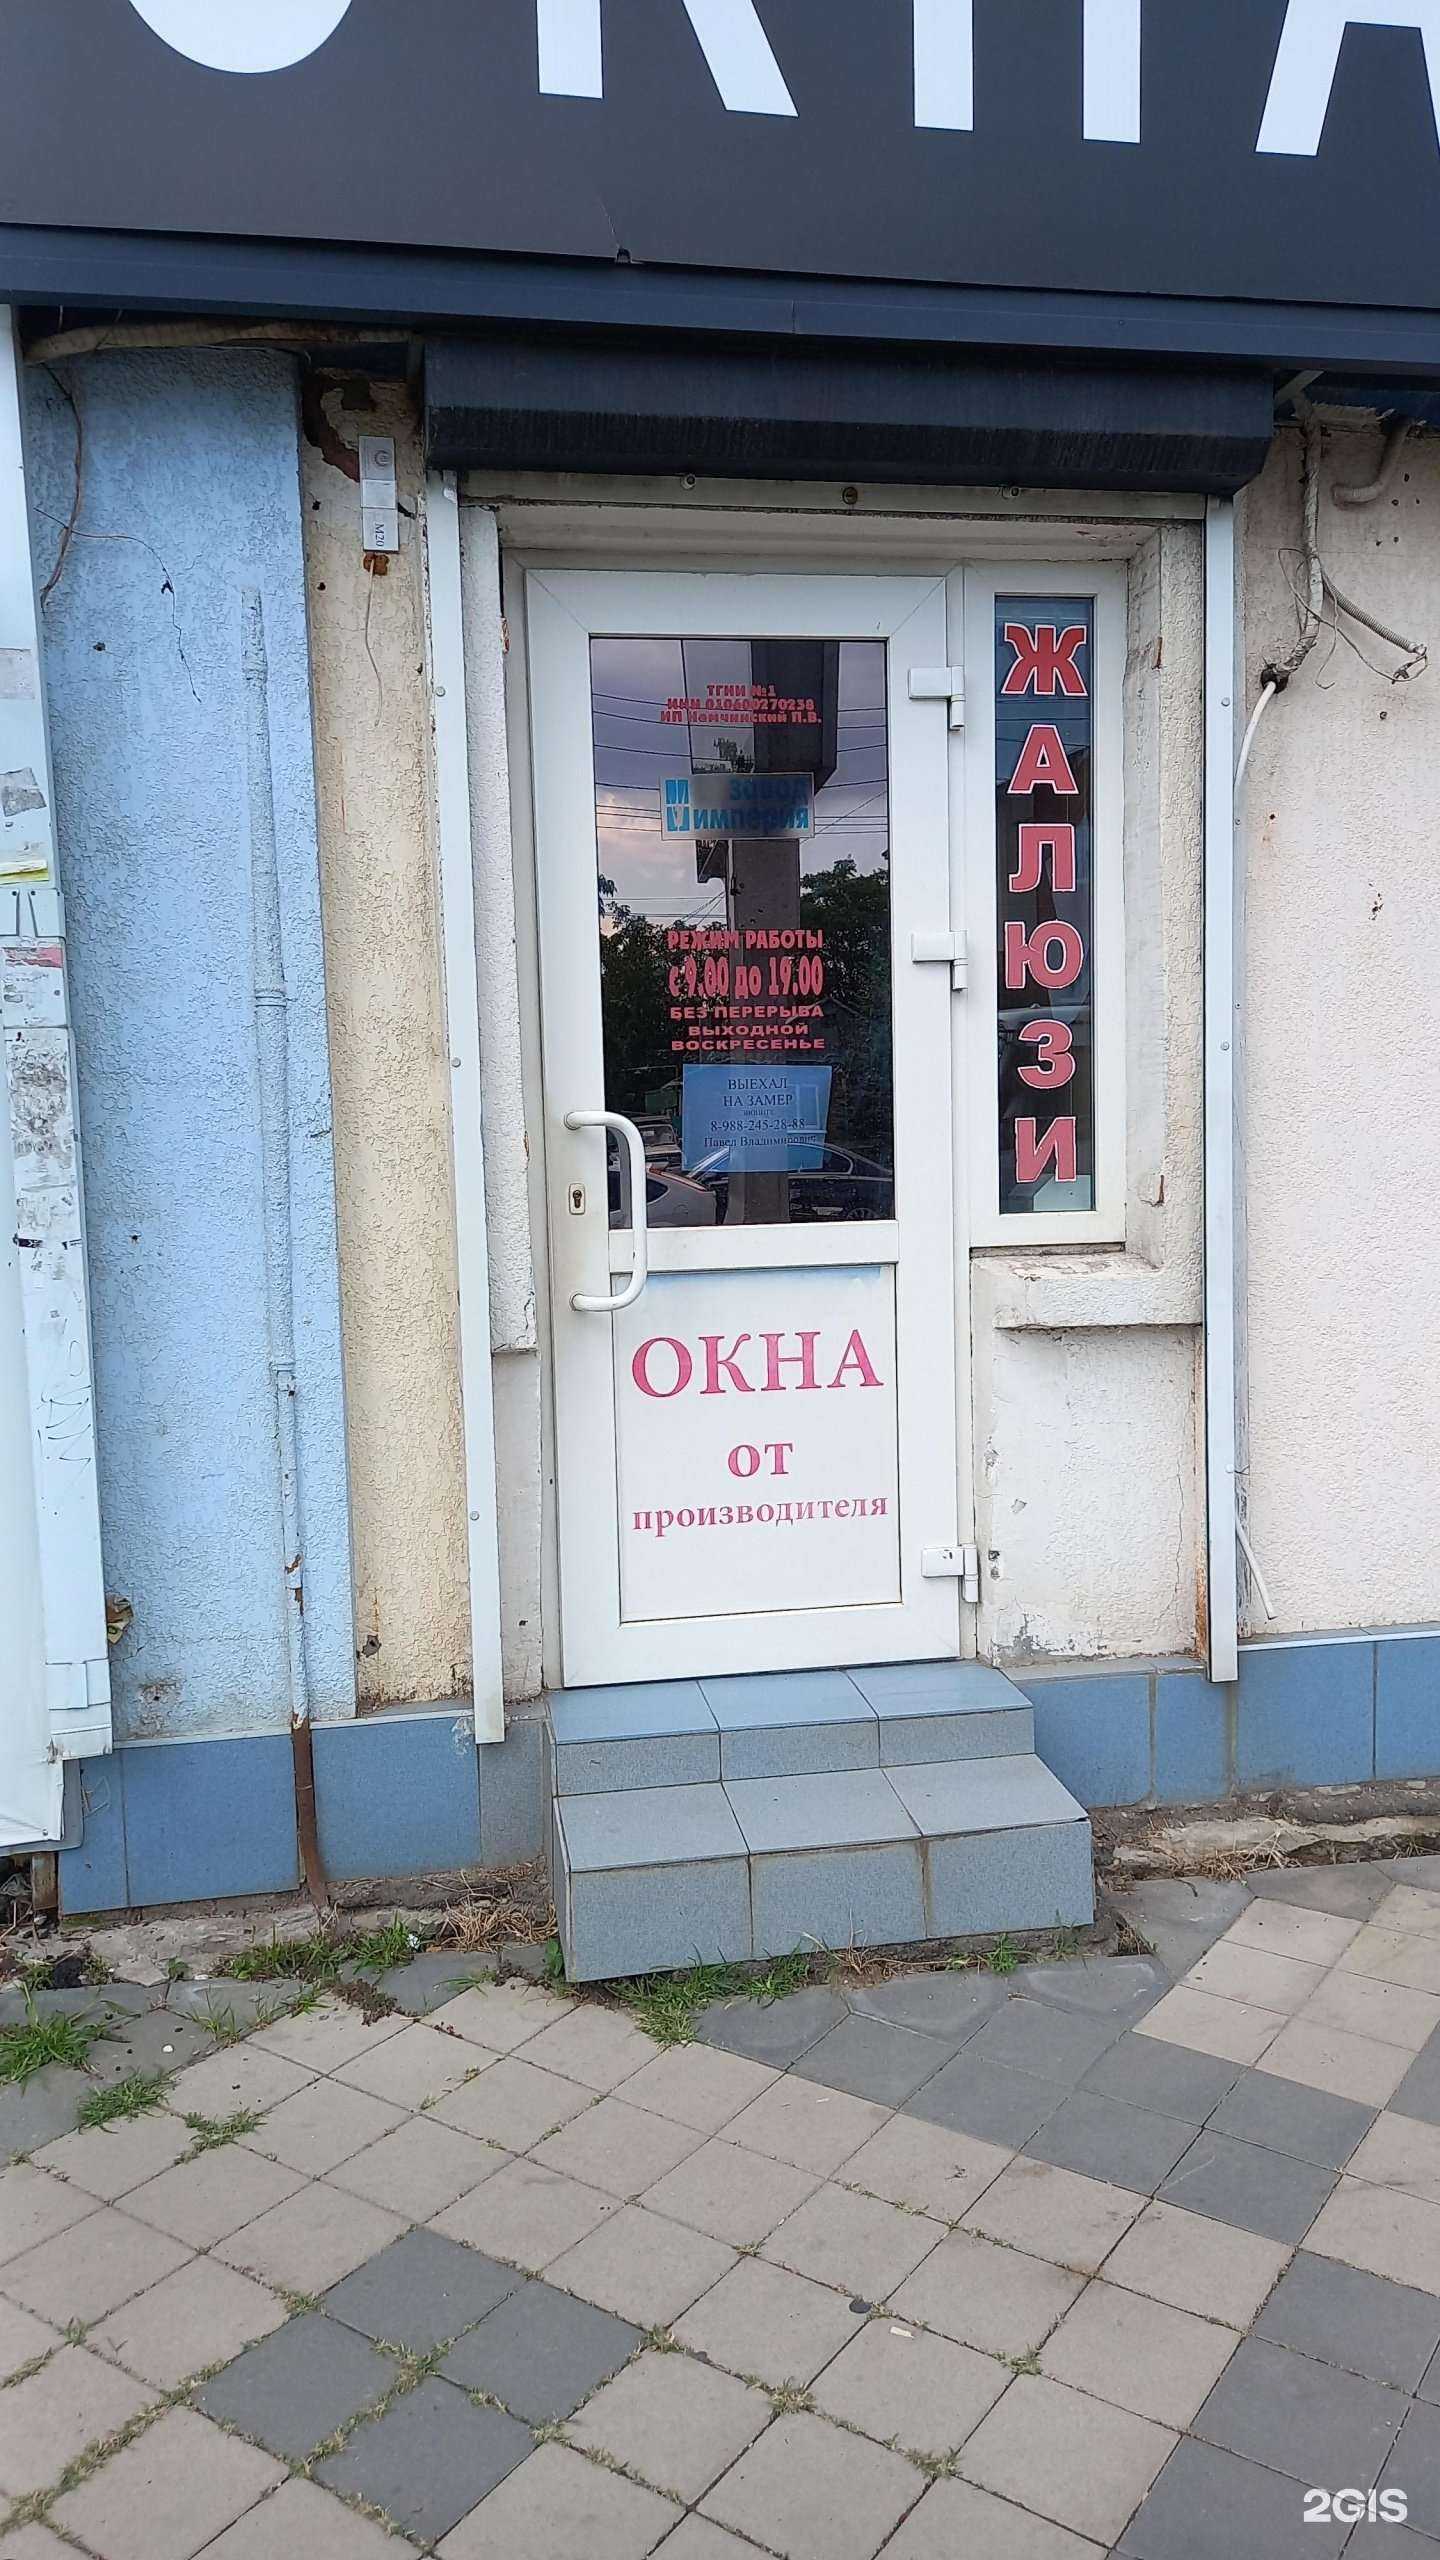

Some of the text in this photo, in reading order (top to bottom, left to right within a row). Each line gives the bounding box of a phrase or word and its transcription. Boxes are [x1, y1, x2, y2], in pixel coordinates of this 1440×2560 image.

[1000, 622, 1088, 1185] ЖАЛЮЗИ
[667, 929, 823, 950] РЕЖИМ РАБОТЫ
[684, 955, 729, 997] 9.00
[769, 955, 824, 996] 19.00
[670, 1005, 825, 1020] БЕЗ ПЕРЕРЫВА
[688, 1022, 809, 1037] ВЫХОДНОЙ
[671, 1038, 825, 1051] ВОСКРЕСЕНЬЕ
[728, 1077, 788, 1090] ВЫЕХАЛ
[723, 1094, 793, 1107] НА ЗАМЕР
[632, 1329, 884, 1397] ОКНА
[632, 1497, 888, 1537] производителя
